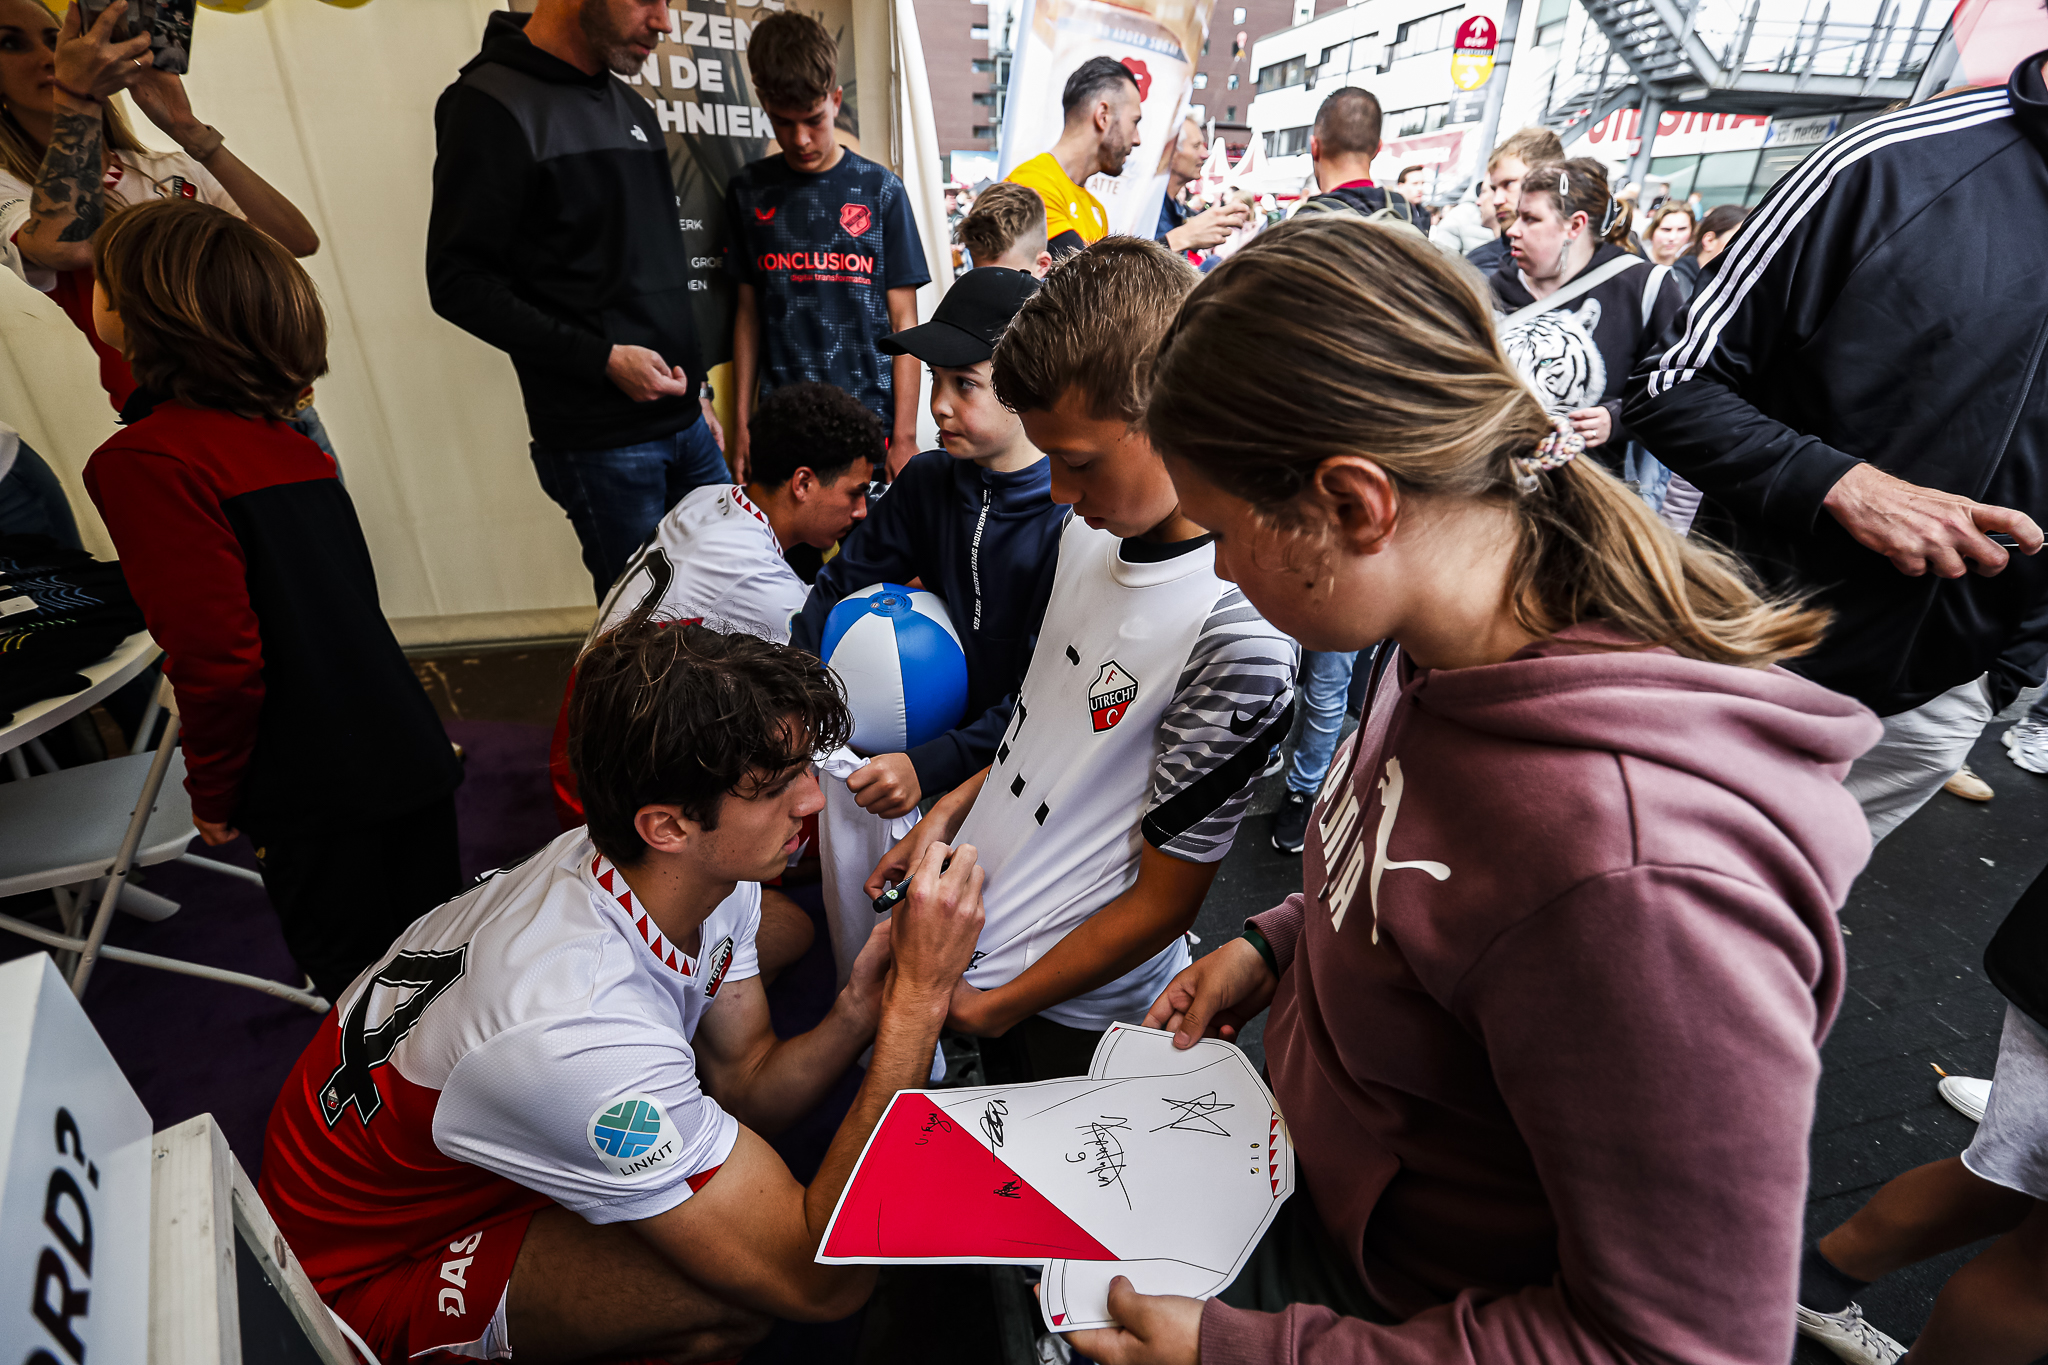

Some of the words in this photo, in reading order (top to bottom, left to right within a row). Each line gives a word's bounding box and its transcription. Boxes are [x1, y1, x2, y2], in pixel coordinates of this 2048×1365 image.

[669, 55, 725, 93] DE
[645, 98, 777, 140] HNIEK
[1091, 177, 1121, 195] ATTE
[1104, 668, 1118, 686] F
[1089, 685, 1137, 712] UTRECHT
[1105, 707, 1119, 727] C
[704, 939, 732, 994] UTRECHT
[619, 1140, 673, 1177] LINKIT
[24, 1105, 100, 1365] RD?
[437, 1230, 484, 1319] DAS
